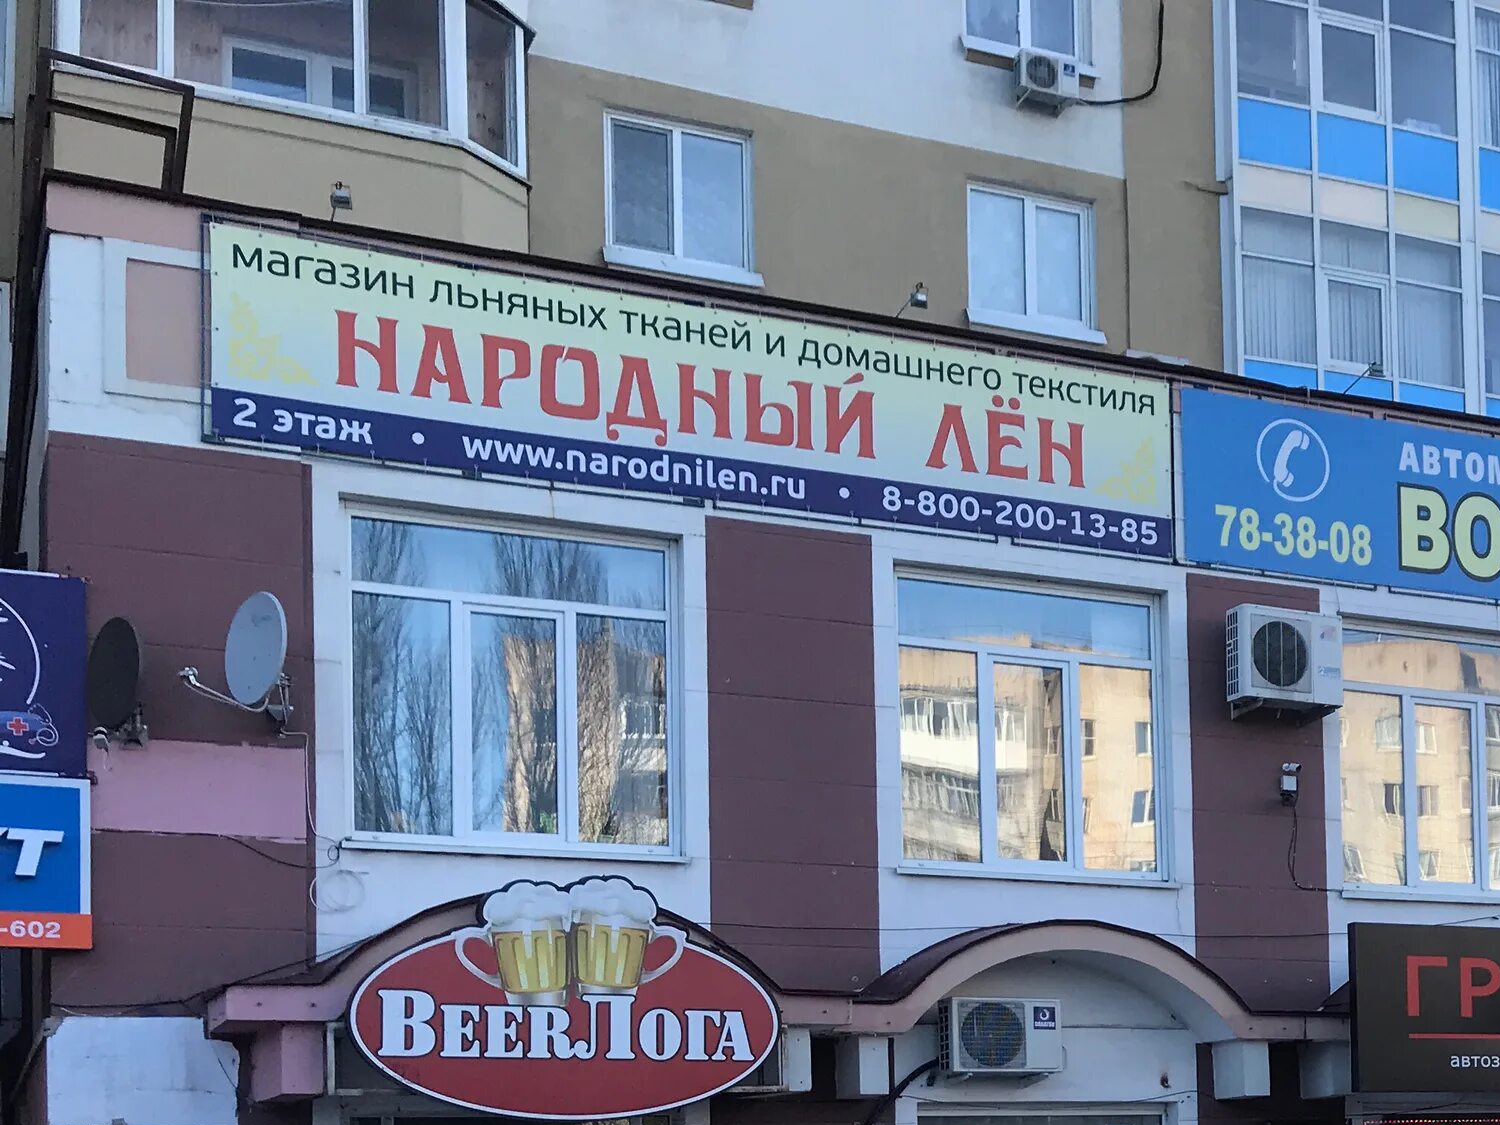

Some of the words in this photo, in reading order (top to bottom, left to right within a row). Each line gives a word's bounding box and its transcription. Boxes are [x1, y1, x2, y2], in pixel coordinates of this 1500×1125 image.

[232, 243, 415, 299] магазин
[428, 279, 608, 331] льняных
[620, 310, 752, 355] тканей
[765, 333, 786, 358] и
[797, 338, 1002, 391] домашнего
[1012, 372, 1157, 417] текстиля
[233, 398, 257, 429] 2
[273, 409, 374, 445] этаж
[335, 308, 877, 460] НАРОДНЫЙ
[925, 393, 1086, 489] ЛЁН
[461, 434, 807, 499] www.narodnilen.ru
[882, 485, 1158, 546] 8-800-200-13-85
[1215, 504, 1373, 566] 78-38-08
